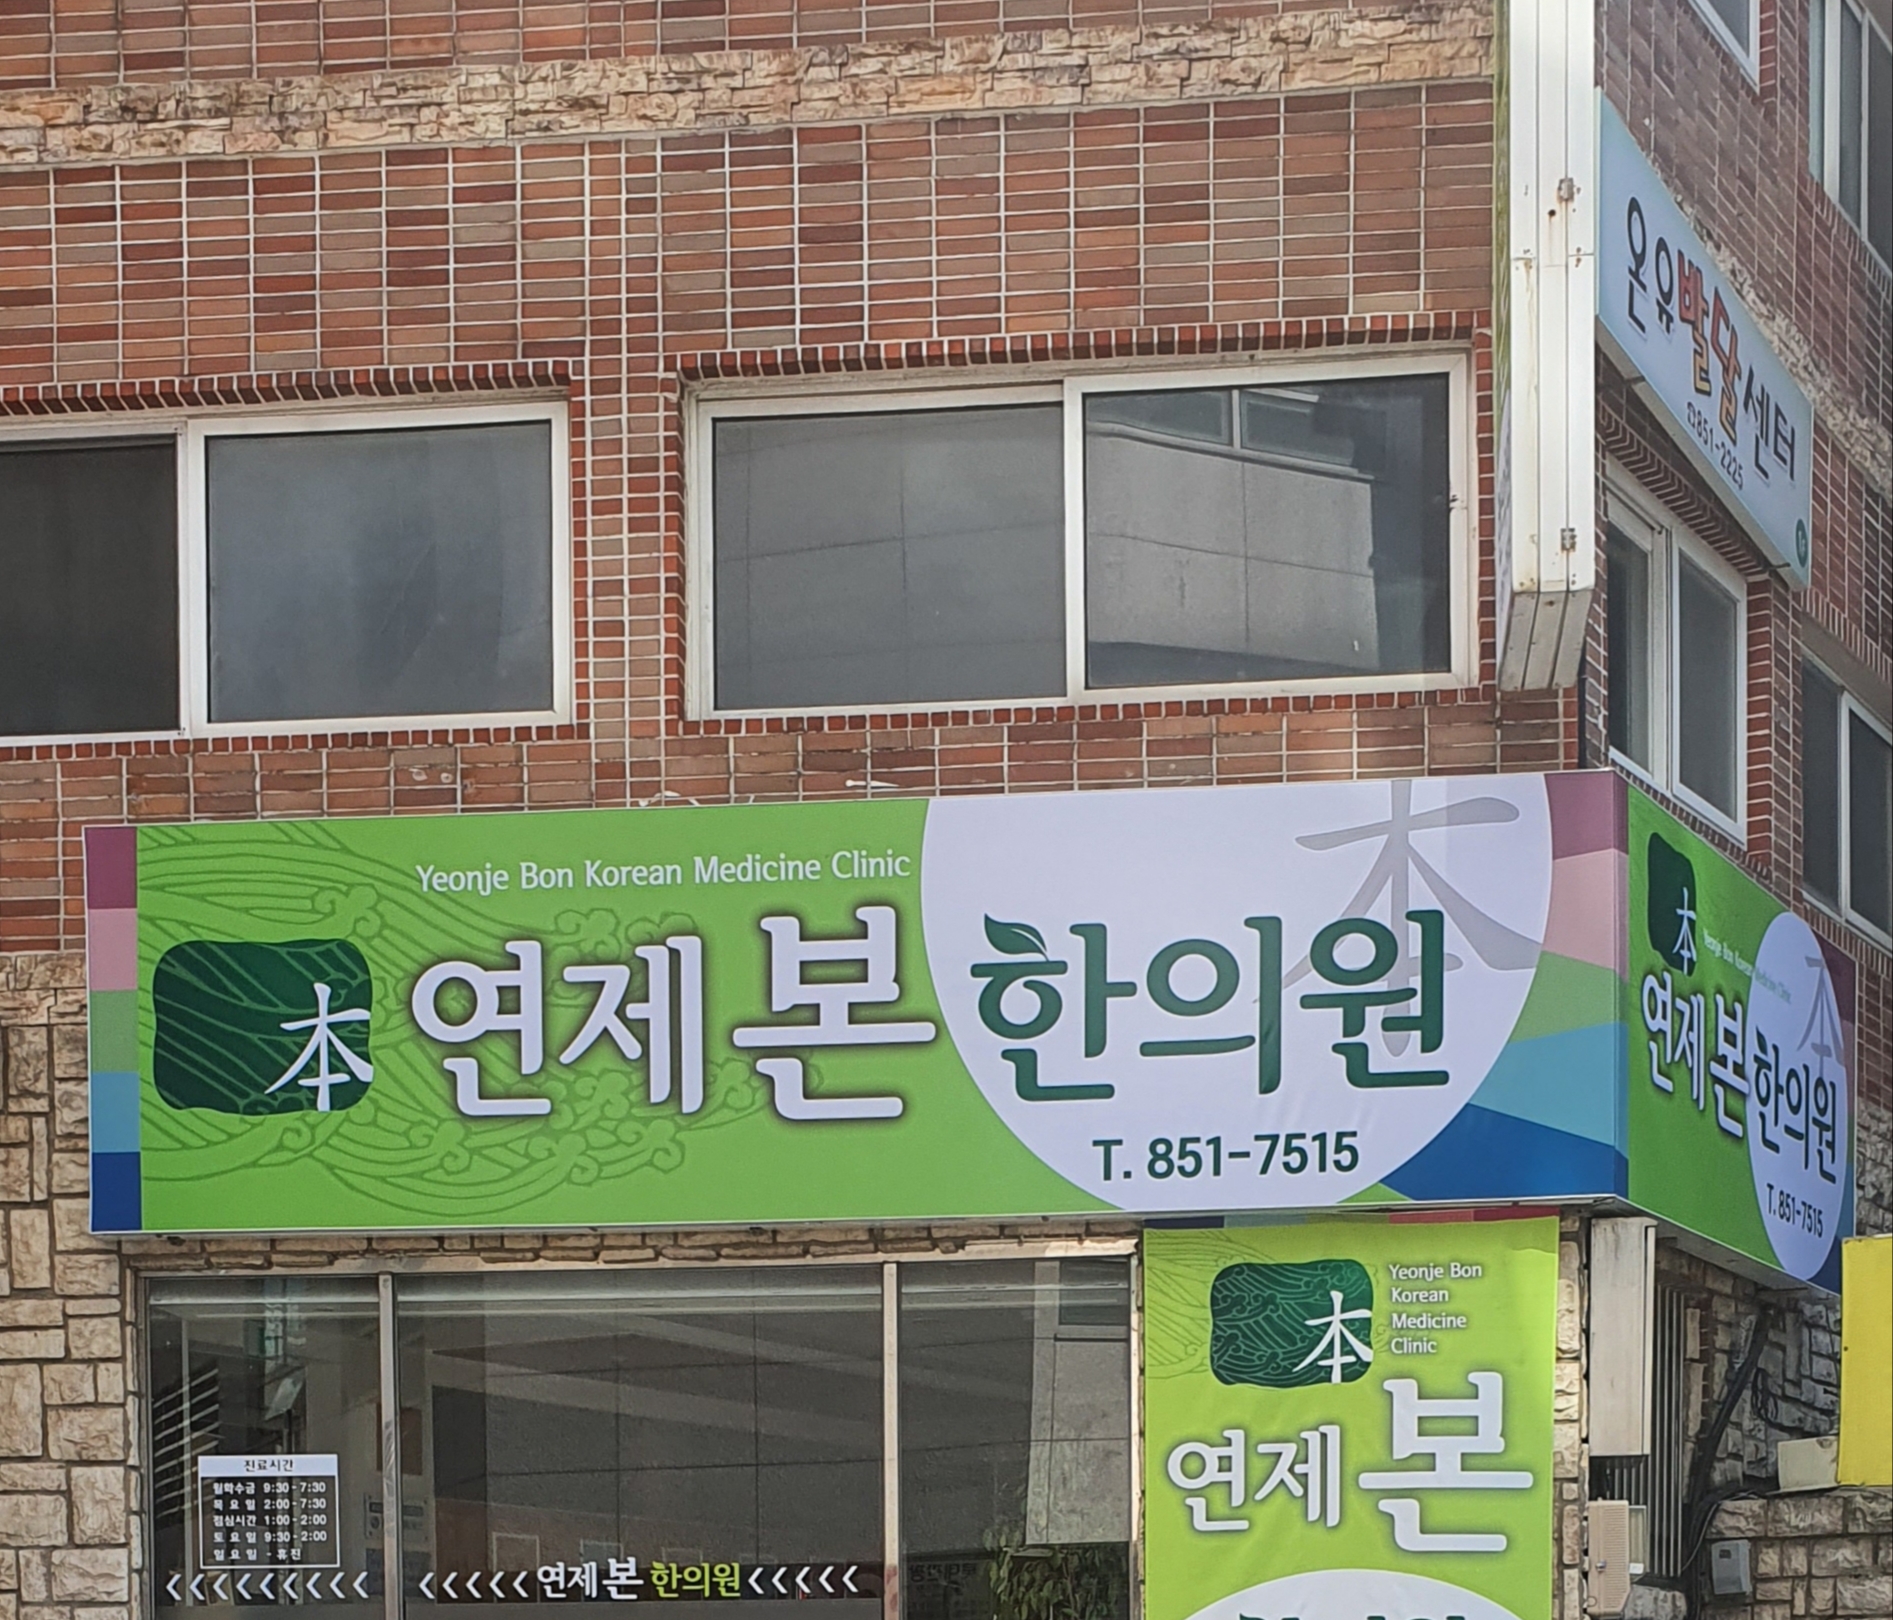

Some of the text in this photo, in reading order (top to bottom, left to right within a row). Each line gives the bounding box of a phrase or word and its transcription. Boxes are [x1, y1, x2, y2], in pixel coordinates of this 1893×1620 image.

[415, 848, 911, 895] Yeonje Bon Korean Medicine Clinic
[411, 906, 1450, 1120] 연제 본 한의원
[1641, 970, 1837, 1184] 연제 본 한의원
[1092, 1130, 1360, 1182] T. 851-7515
[1778, 1188, 1824, 1239] 851-7515
[1388, 1261, 1483, 1284] Yeonje Bon
[1390, 1287, 1450, 1304] Korean
[1391, 1312, 1468, 1330] Medicine
[1390, 1337, 1438, 1354] Clinic
[244, 1459, 294, 1472] 진료시간
[1167, 1371, 1535, 1552] 연제 본
[536, 1555, 741, 1600] 연제 본 한의원
